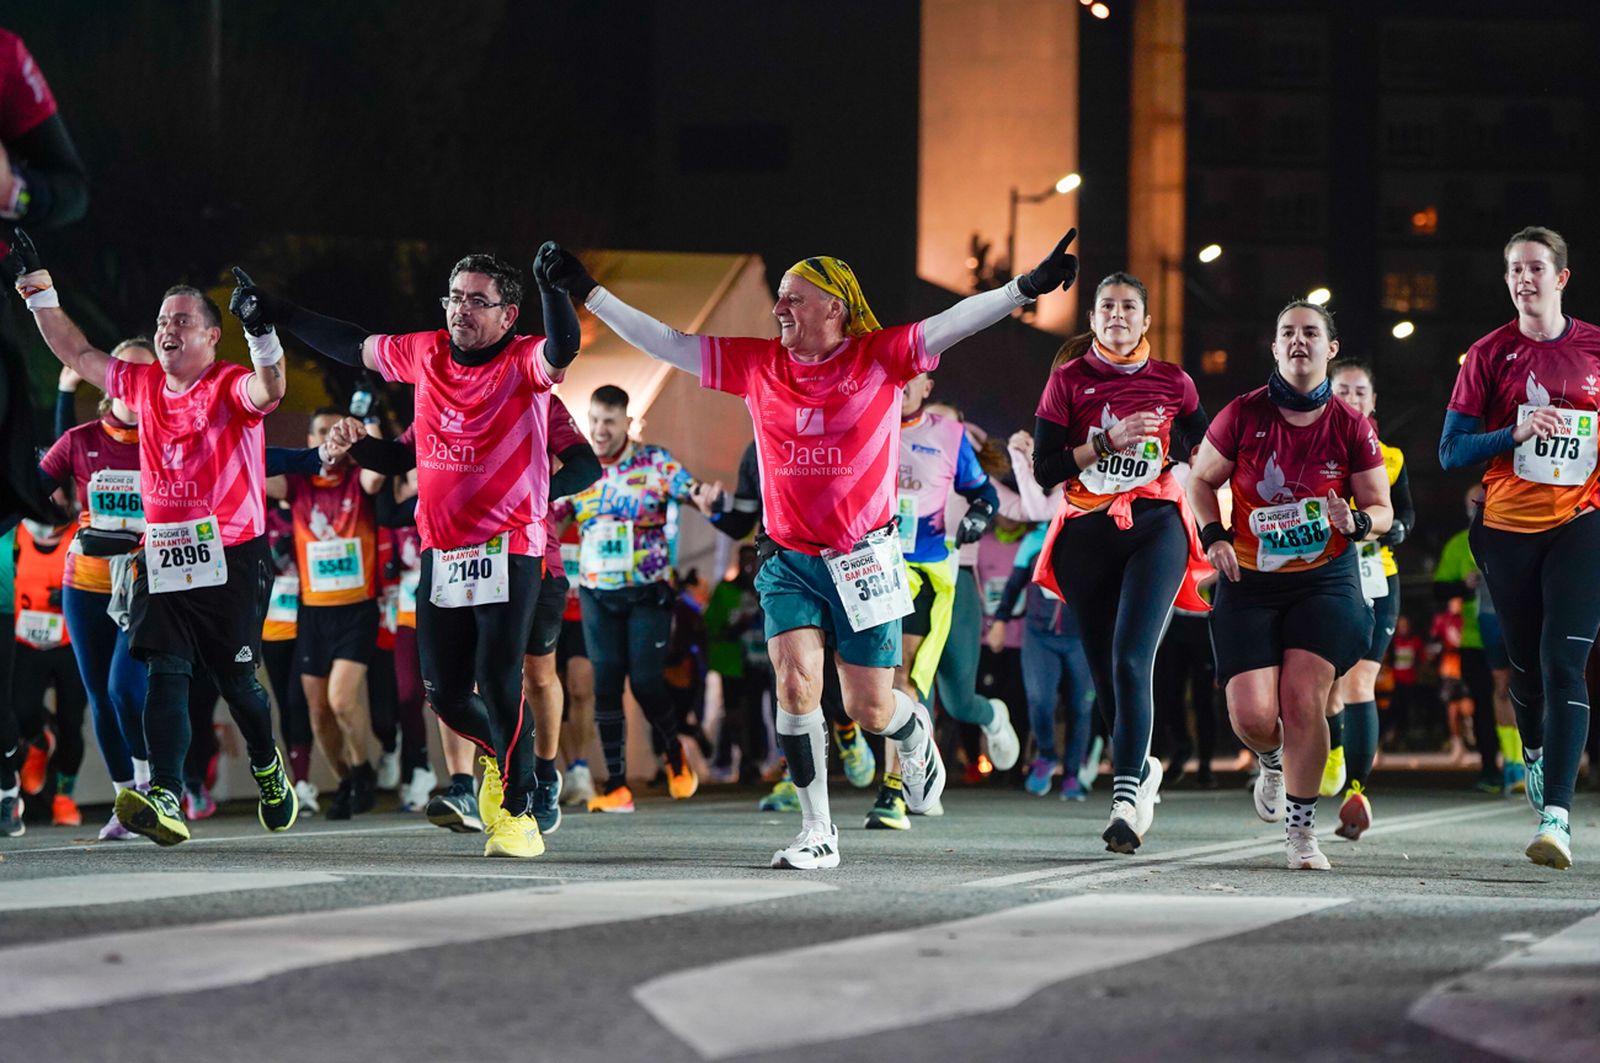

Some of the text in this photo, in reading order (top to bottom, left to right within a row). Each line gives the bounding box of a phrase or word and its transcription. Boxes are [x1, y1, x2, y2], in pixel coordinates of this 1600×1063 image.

[427, 434, 475, 463] Jaén
[781, 440, 842, 466] Jaén
[1534, 436, 1580, 460] 6773
[446, 462, 485, 473] INTERIOR
[775, 466, 854, 476] PARAÍSO INTERIOR
[1096, 455, 1149, 478] 5090
[148, 471, 198, 498] Jaén
[96, 493, 145, 512] 1346
[169, 499, 209, 507] INTERIOR
[1267, 512, 1291, 521] NOCHE
[1291, 510, 1300, 518] DE
[158, 531, 181, 539] NOCHE
[181, 529, 190, 538] DE
[1260, 522, 1276, 532] SAN
[1265, 520, 1326, 549] 12838
[152, 540, 167, 548] SAN
[167, 536, 193, 548] ANTÓN
[159, 543, 211, 569] 2896
[441, 554, 456, 562] SAN
[849, 555, 875, 570] NOCHE
[447, 557, 493, 584] 2140
[844, 570, 862, 581] SAN
